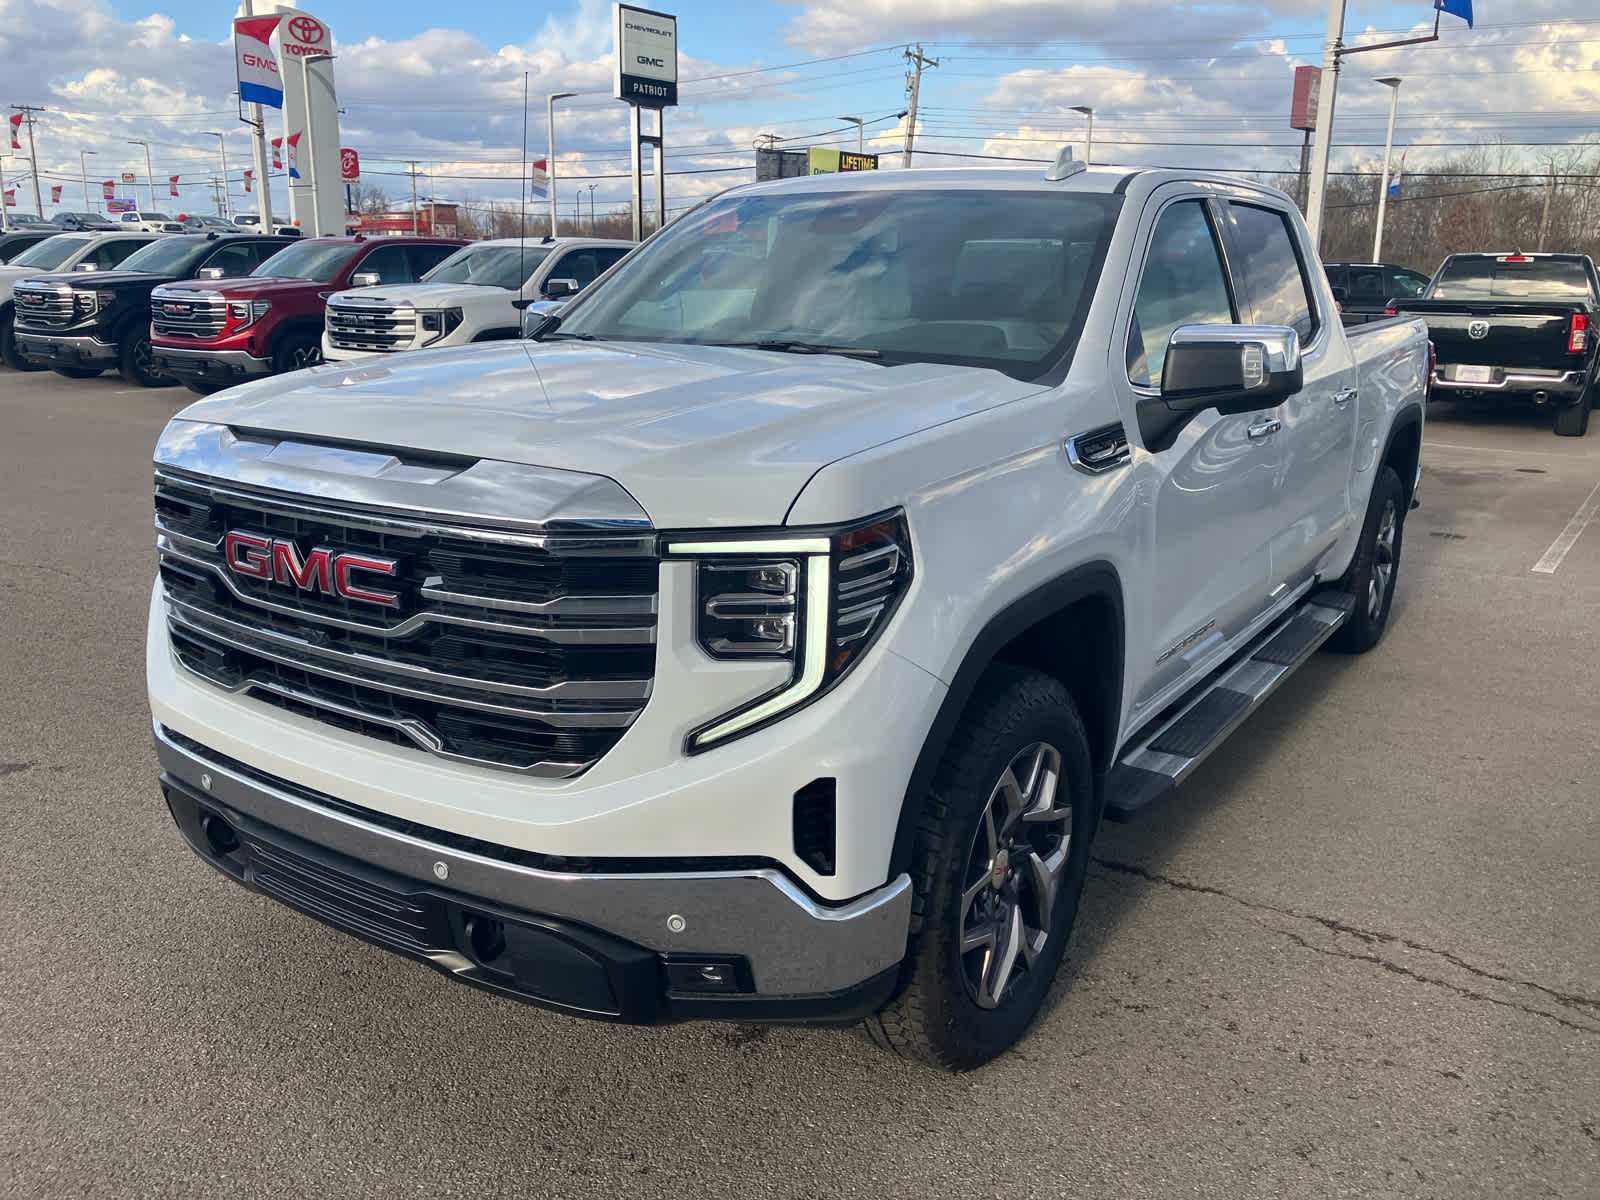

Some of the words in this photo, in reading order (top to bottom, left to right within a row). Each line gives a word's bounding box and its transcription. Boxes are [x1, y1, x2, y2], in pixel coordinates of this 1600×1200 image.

[625, 23, 672, 38] CHEVROLET
[243, 54, 278, 72] GMC
[637, 55, 664, 67] GMC
[633, 83, 667, 96] PATRIOT
[842, 155, 874, 170] LIFETIME
[225, 528, 401, 609] GMC
